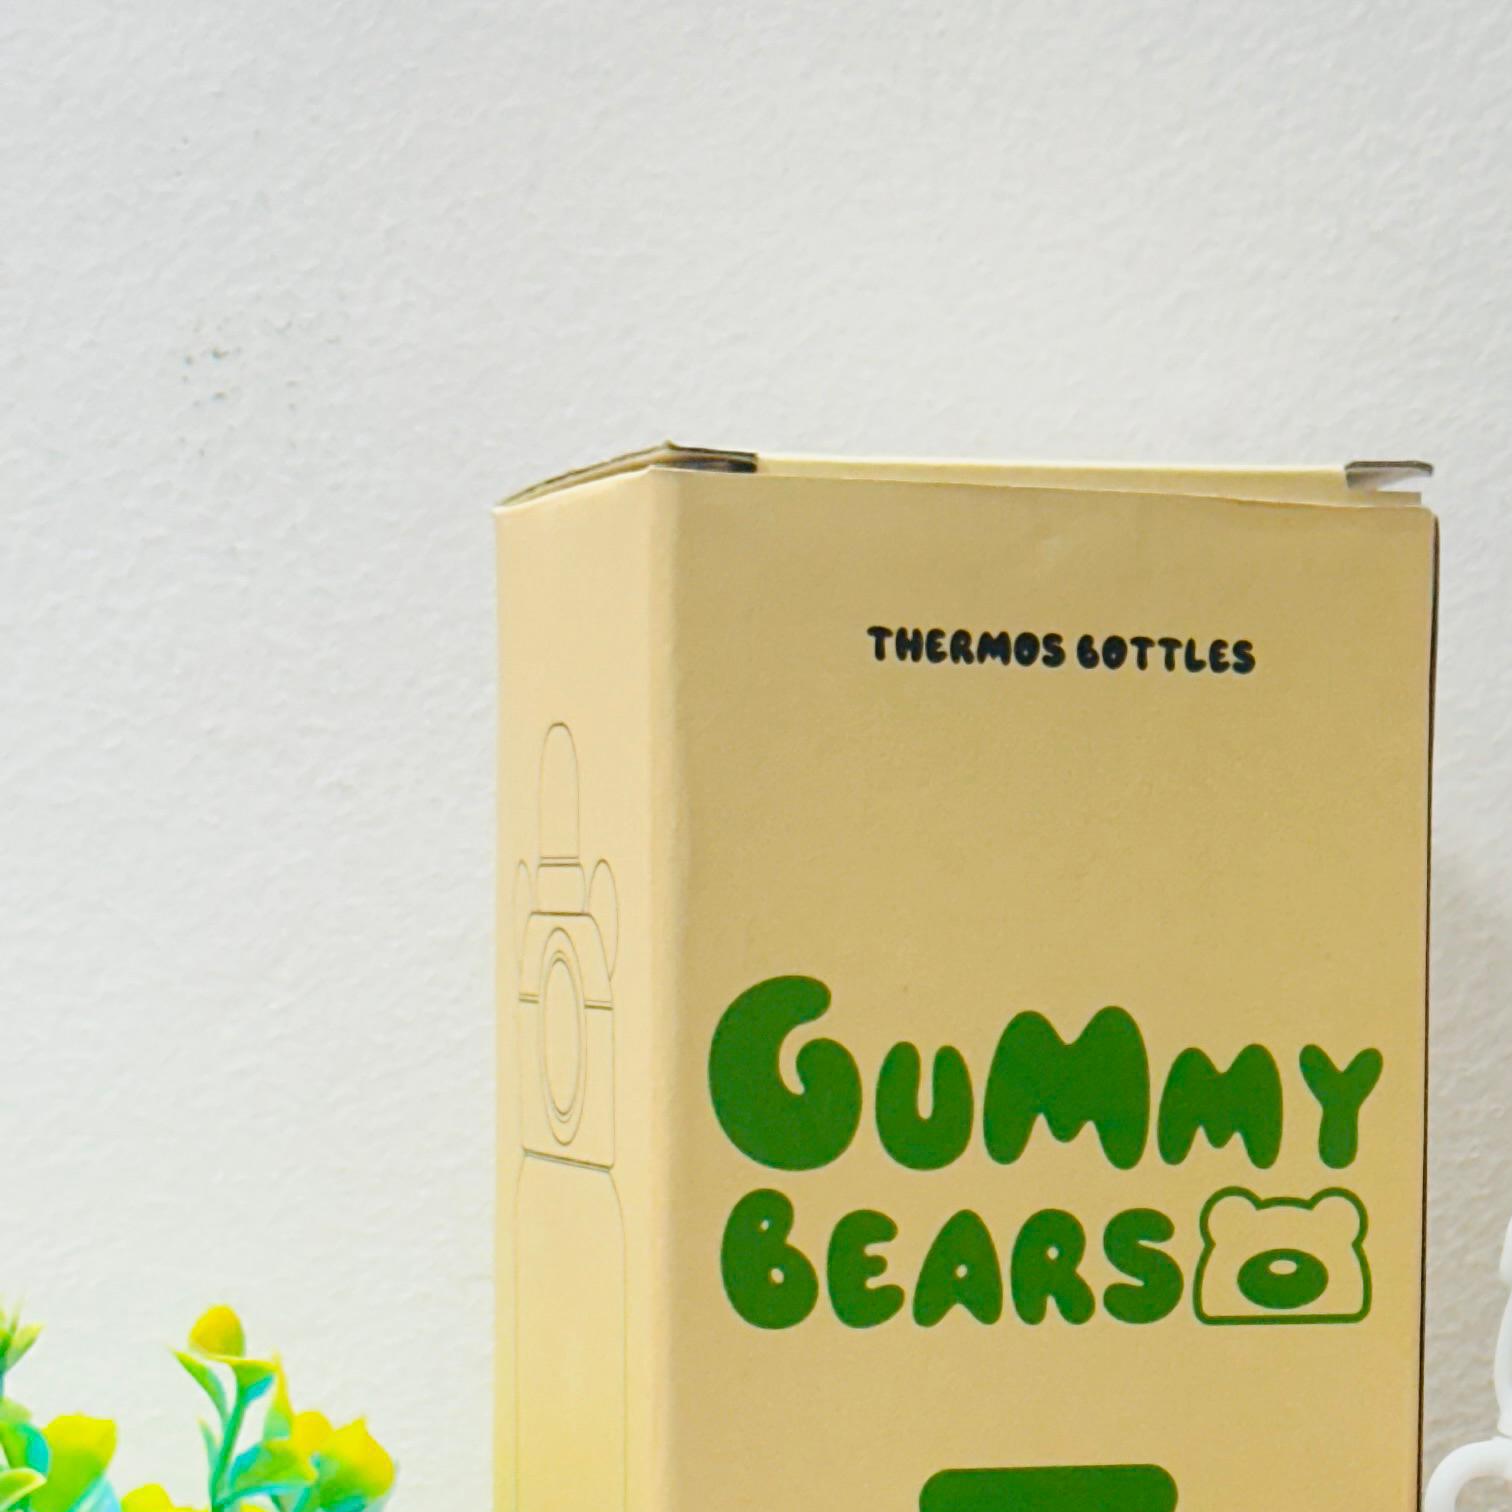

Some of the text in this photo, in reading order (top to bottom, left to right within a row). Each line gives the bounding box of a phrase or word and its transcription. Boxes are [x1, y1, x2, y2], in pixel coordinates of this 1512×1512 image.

[867, 626, 1256, 675] THERMOS BOTTLES
[708, 974, 1384, 1171] GUMMY
[720, 1188, 1184, 1329] BEARS
